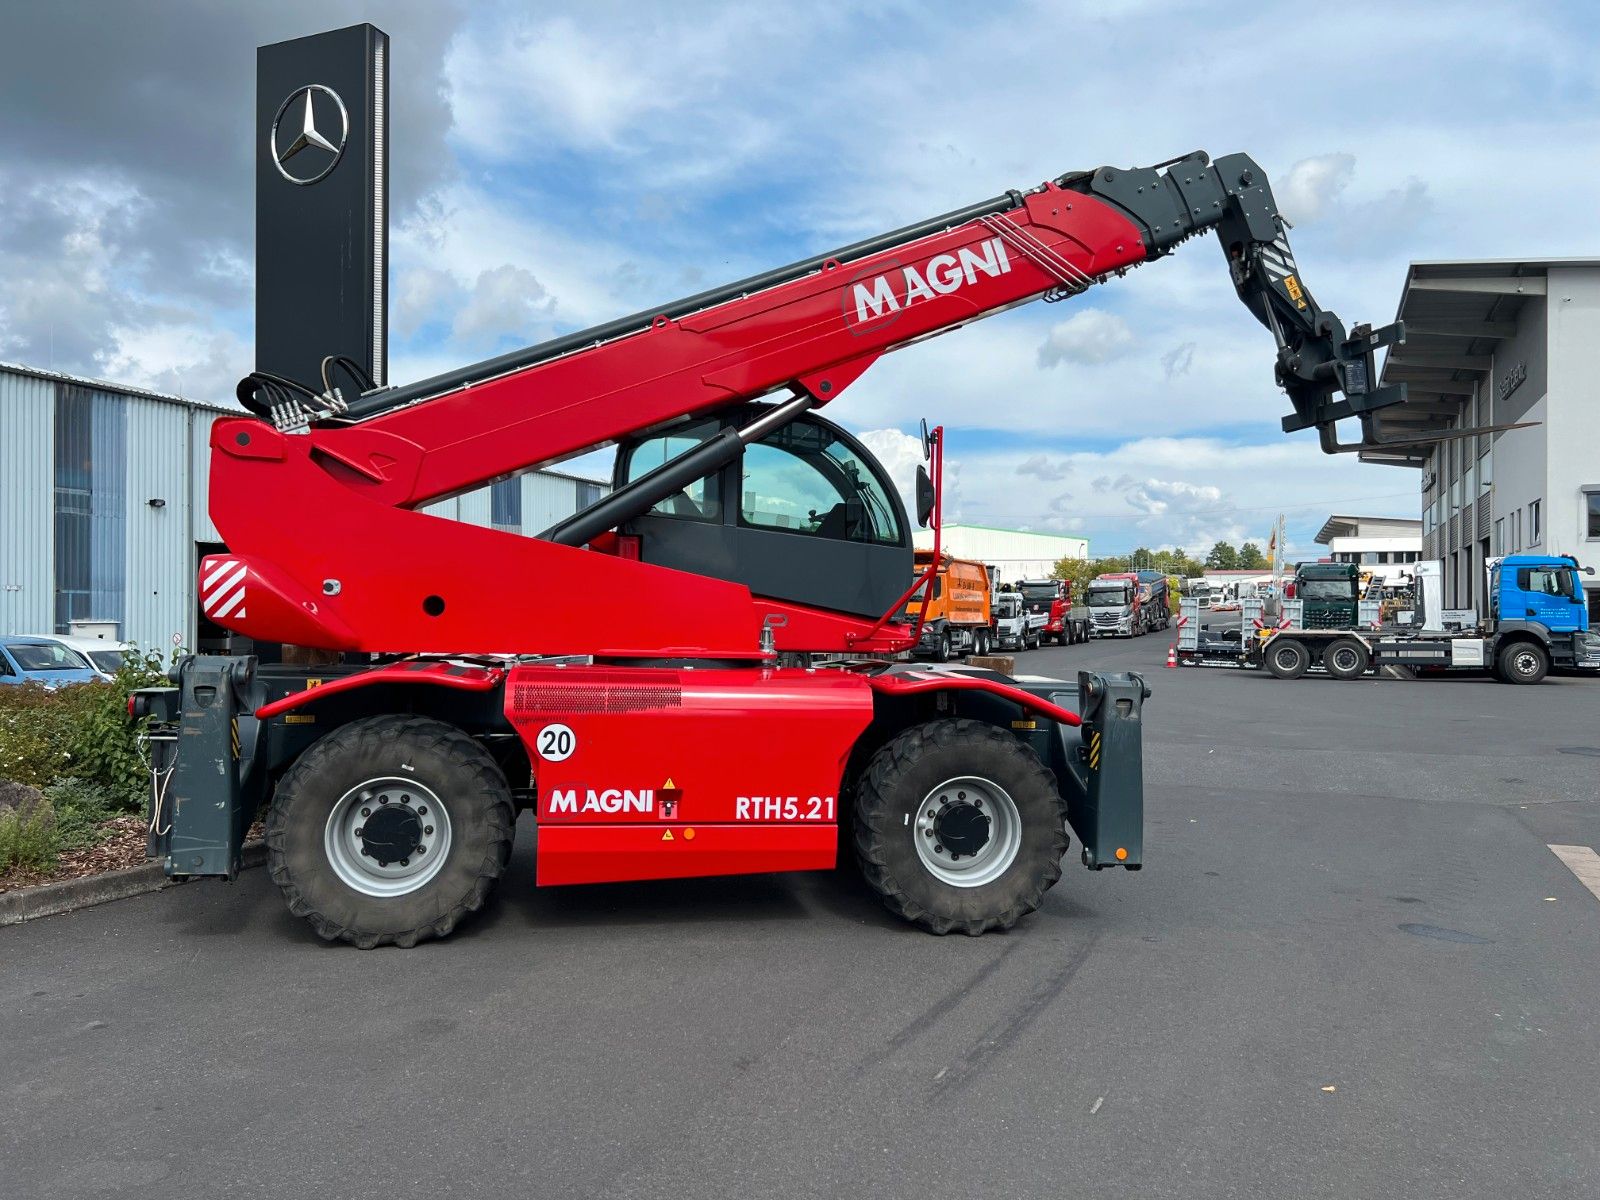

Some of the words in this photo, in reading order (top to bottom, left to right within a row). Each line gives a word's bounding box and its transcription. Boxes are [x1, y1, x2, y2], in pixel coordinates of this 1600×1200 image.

[854, 238, 1011, 322] MAGNI
[542, 731, 571, 755] 20
[550, 790, 653, 812] MAGNI
[737, 797, 833, 819] RTH5.21
